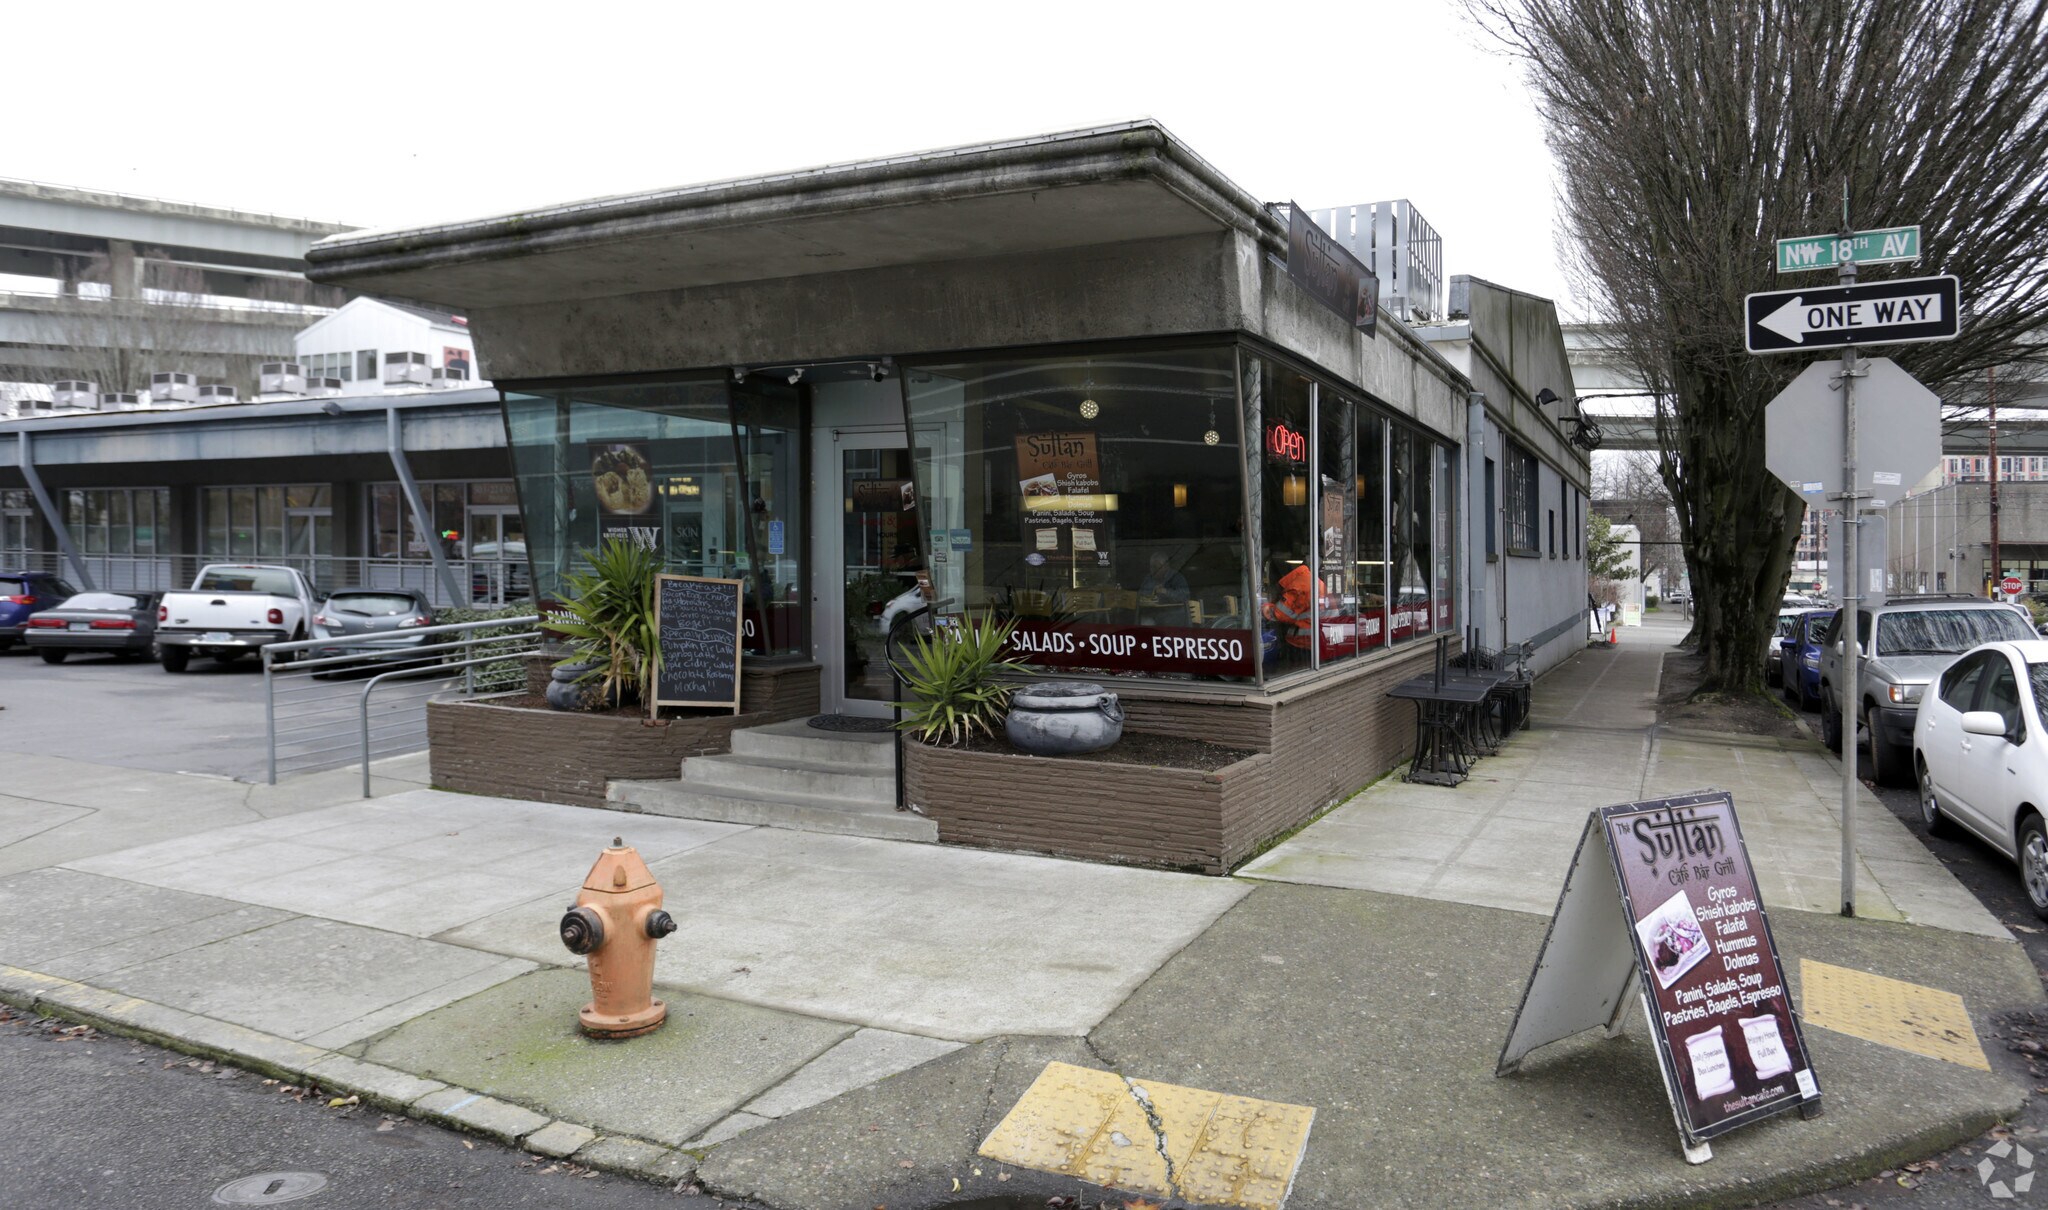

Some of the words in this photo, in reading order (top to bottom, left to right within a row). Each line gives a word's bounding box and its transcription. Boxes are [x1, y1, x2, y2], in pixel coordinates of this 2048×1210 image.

[1785, 244, 1820, 266] NW
[1881, 233, 1911, 257] AV
[1807, 304, 1862, 329] ONE
[1874, 298, 1932, 323] WAY
[1027, 431, 1086, 457] Sultan
[1066, 472, 1087, 480] Gyros
[2002, 582, 2021, 590] STOP
[1011, 630, 1075, 653] SALADS
[1090, 633, 1136, 656] SOUP
[1152, 636, 1244, 662] ESPRESSO
[1615, 821, 1631, 836] The
[1633, 803, 1726, 866] Sultan
[1693, 863, 1710, 881] Bar
[1714, 856, 1736, 877] Grill
[1707, 885, 1738, 905] Gyros
[1696, 903, 1725, 923] Shish
[1722, 897, 1757, 917] kabobs
[1715, 915, 1749, 936] Falafel
[1714, 935, 1757, 954] Hummus
[1723, 952, 1759, 972] Dolmas
[1739, 971, 1763, 988] Soup
[1740, 984, 1782, 1008] Espresso
[1723, 1084, 1785, 1113] thesultancafe.com
